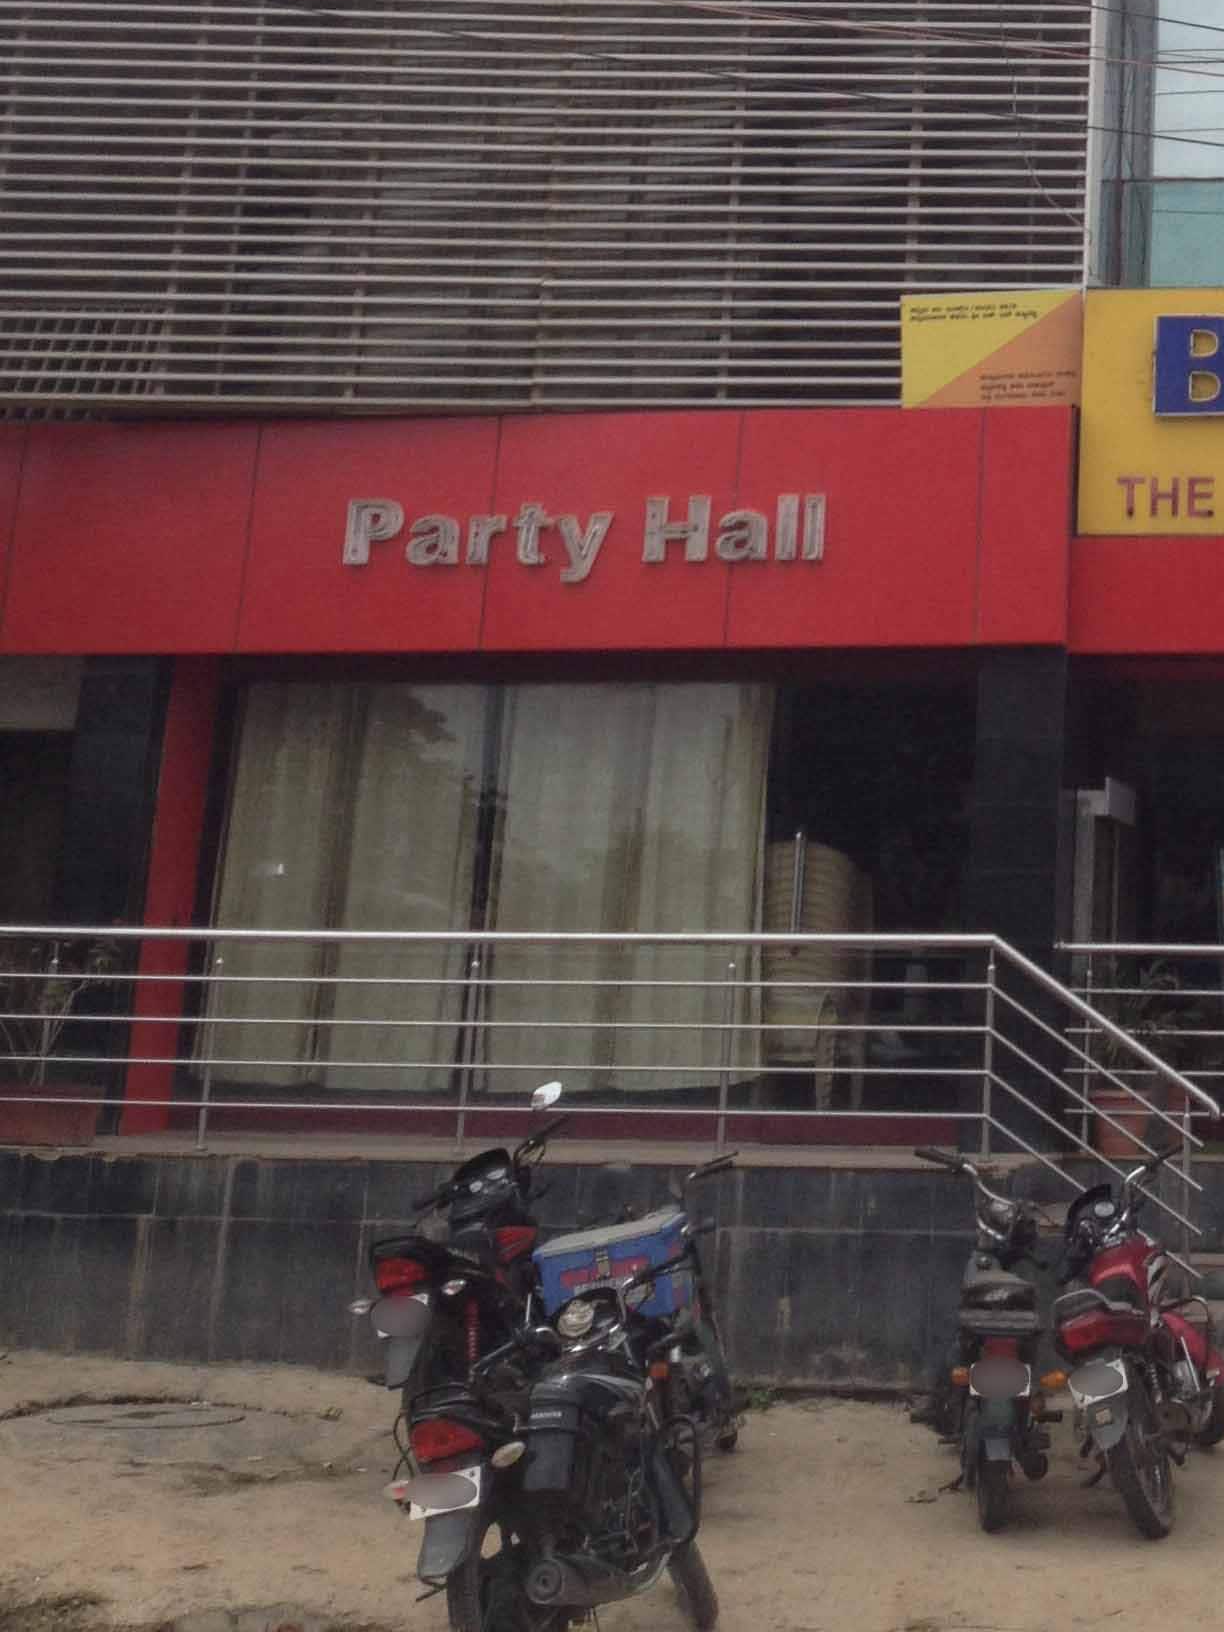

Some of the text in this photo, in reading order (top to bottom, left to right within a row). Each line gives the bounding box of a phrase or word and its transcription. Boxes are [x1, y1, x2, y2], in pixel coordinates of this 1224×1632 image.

[1118, 475, 1213, 520] THE
[343, 493, 827, 583] Party Hall
